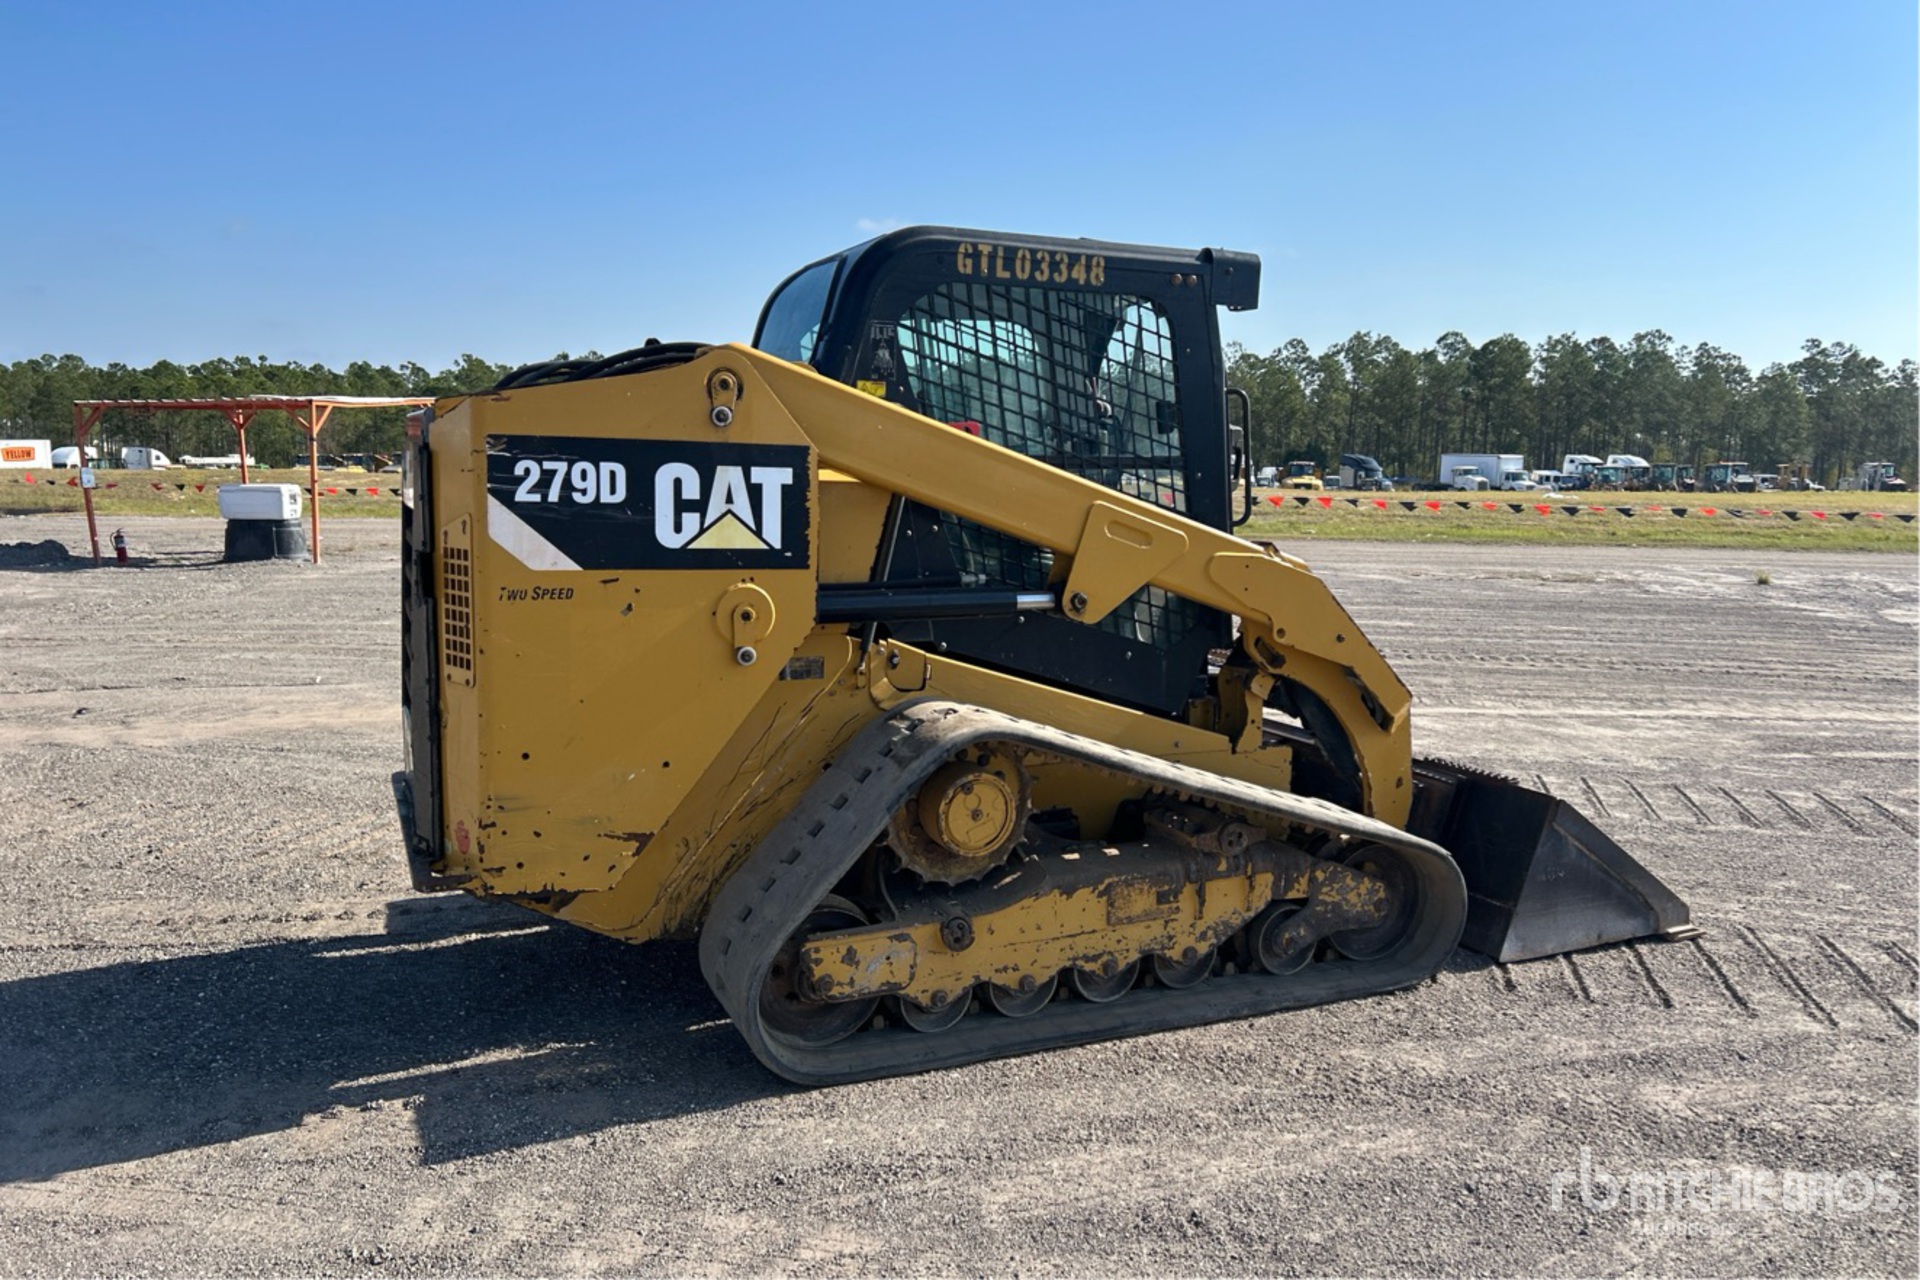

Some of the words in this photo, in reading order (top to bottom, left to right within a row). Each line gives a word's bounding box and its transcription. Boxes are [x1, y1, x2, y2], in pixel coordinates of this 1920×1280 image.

[957, 243, 1105, 286] GTL03348
[6, 450, 32, 459] YELLOW
[513, 459, 627, 504] 279D
[654, 462, 794, 550] CAT
